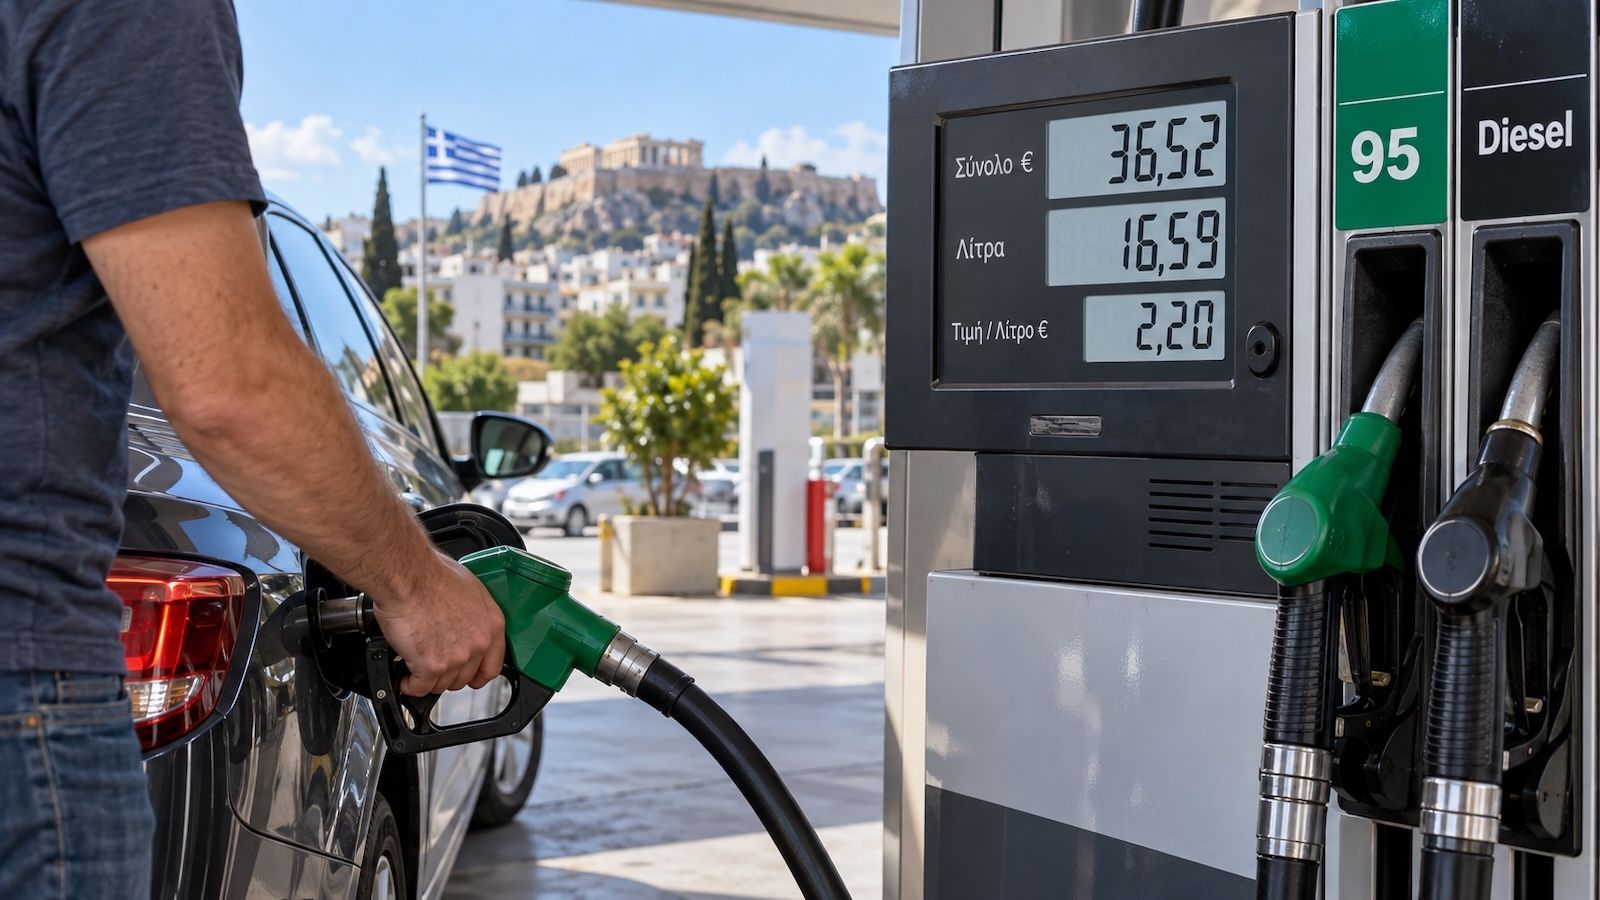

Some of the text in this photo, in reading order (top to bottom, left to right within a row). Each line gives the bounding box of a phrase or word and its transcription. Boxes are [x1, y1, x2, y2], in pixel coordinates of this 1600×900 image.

[1108, 114, 1220, 187] 36,52
[1351, 127, 1419, 184] 95
[1479, 110, 1573, 156] Diesel
[955, 150, 1034, 179] Σύνολο €
[956, 236, 1005, 264] Λίτρα
[1123, 210, 1220, 277] 16,59
[951, 319, 1049, 346] Τιμή / Λίτρο €
[1136, 300, 1214, 356] 2,20
